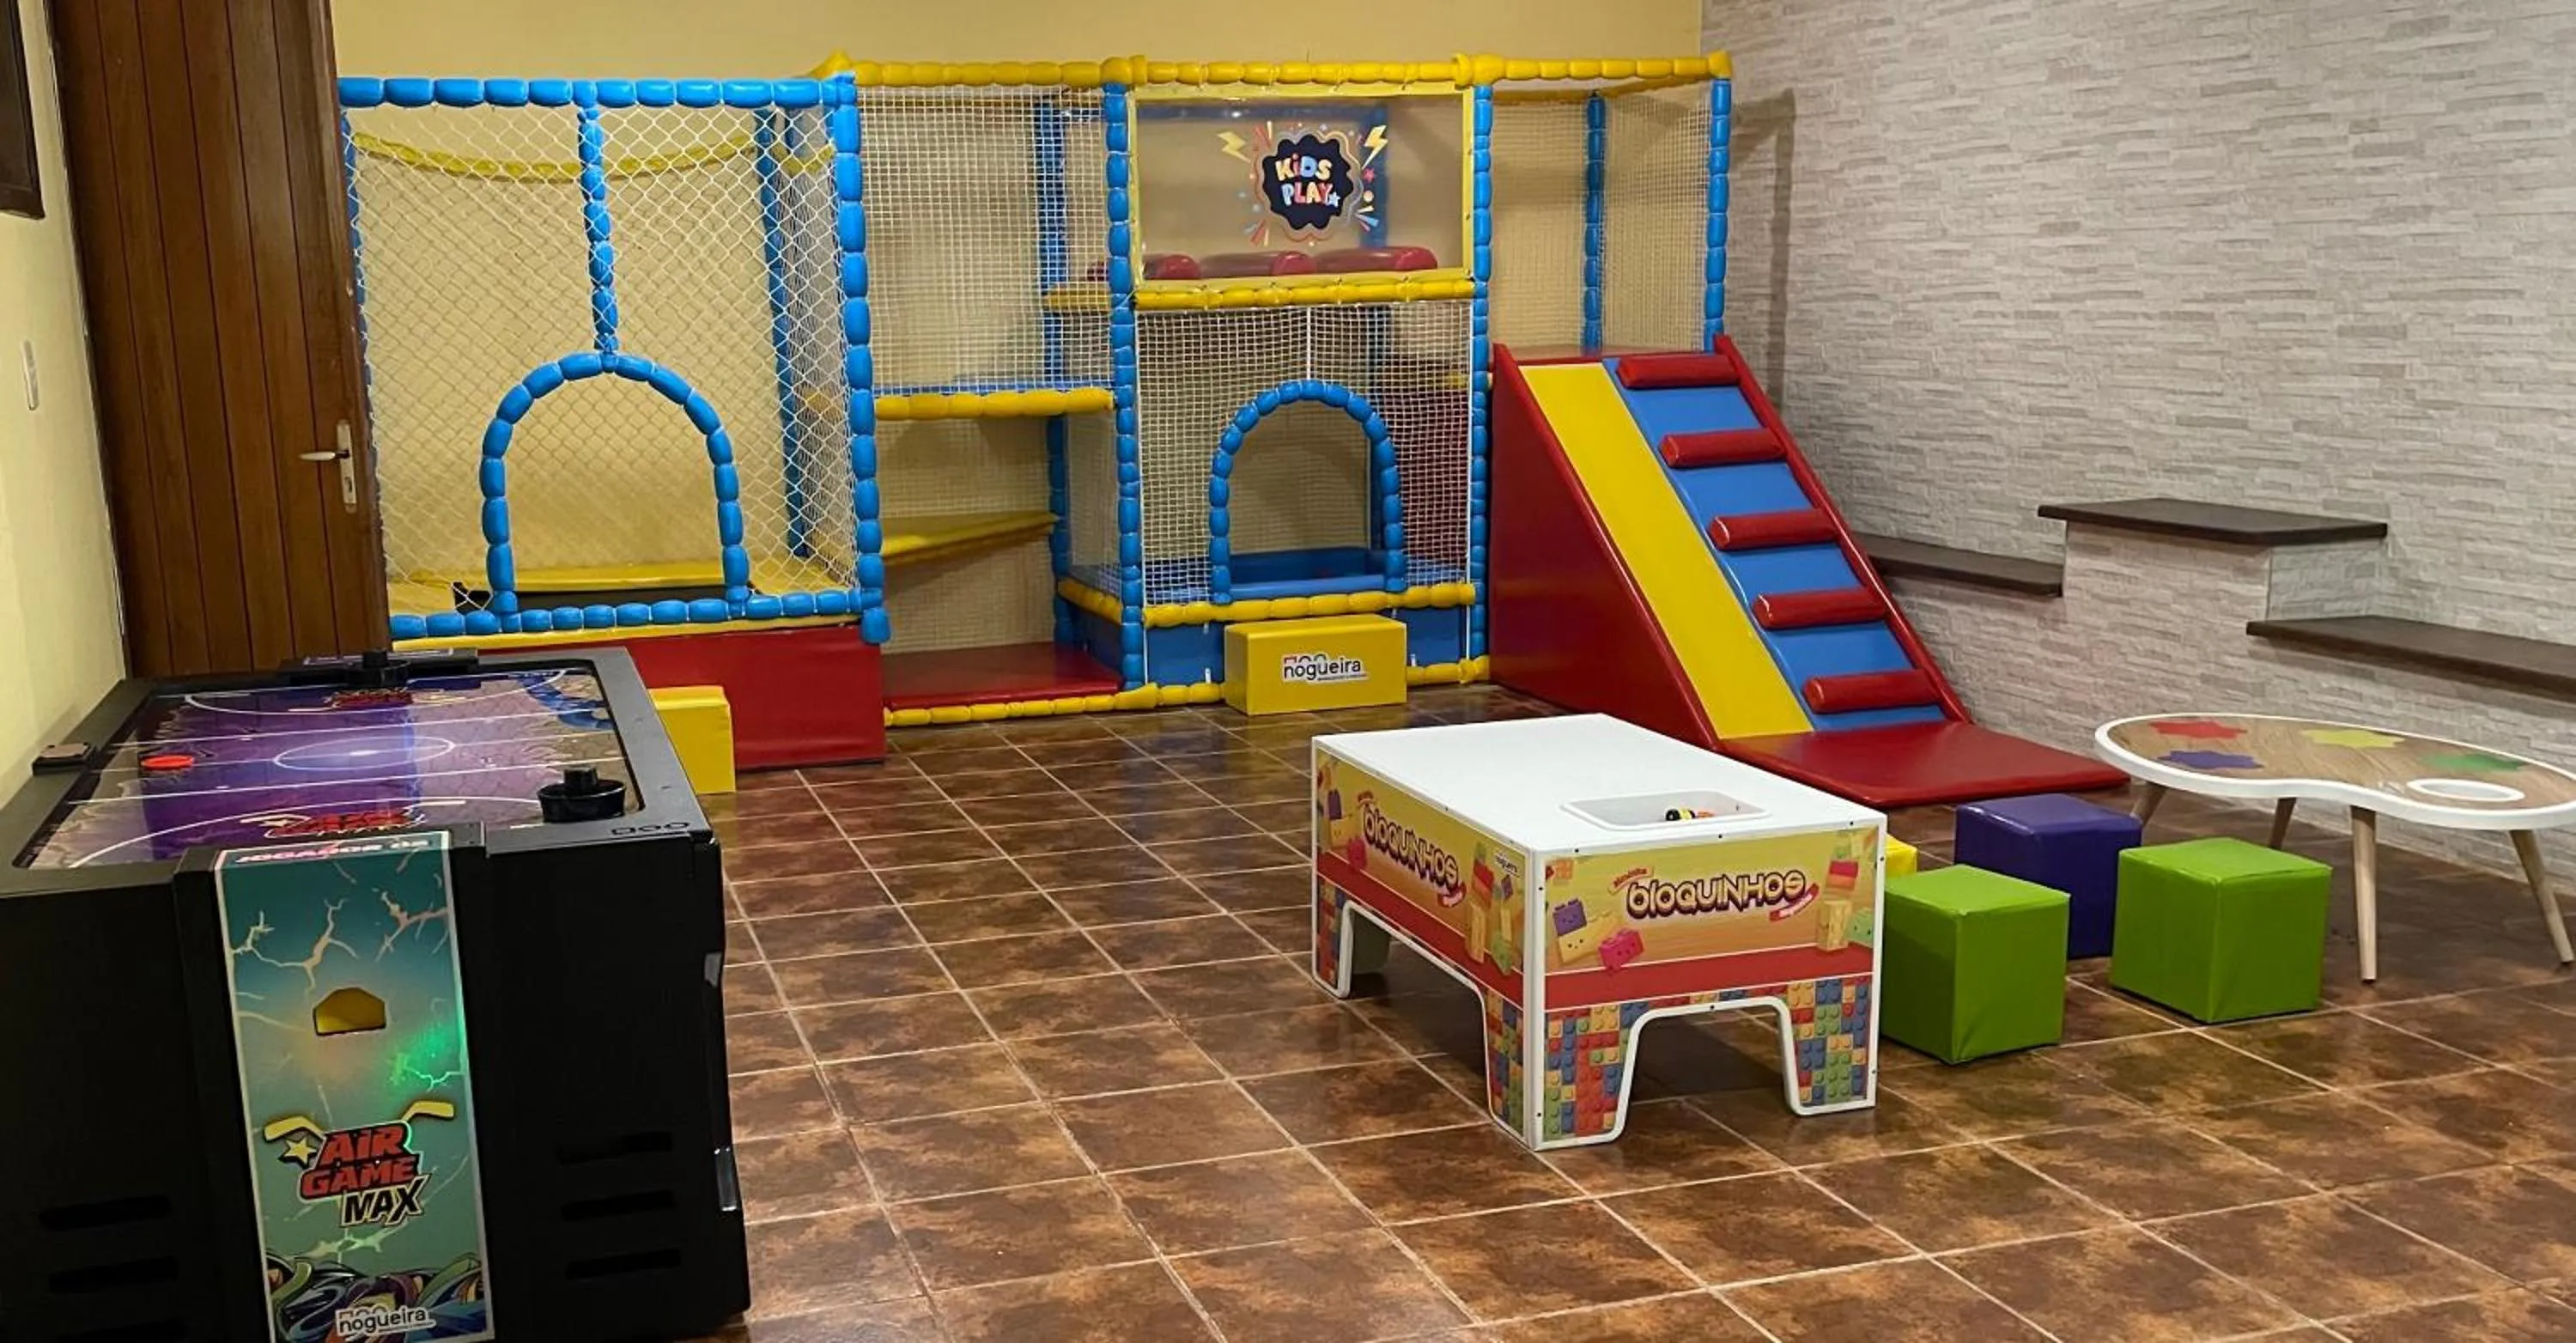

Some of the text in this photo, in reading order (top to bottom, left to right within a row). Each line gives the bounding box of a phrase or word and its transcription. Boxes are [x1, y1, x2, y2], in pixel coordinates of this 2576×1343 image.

[1281, 181, 1333, 206] PLAY
[1284, 657, 1361, 681] nogueira
[301, 1156, 416, 1199] GAME
[343, 1174, 431, 1225] MAX
[339, 1308, 426, 1334] nogueira
